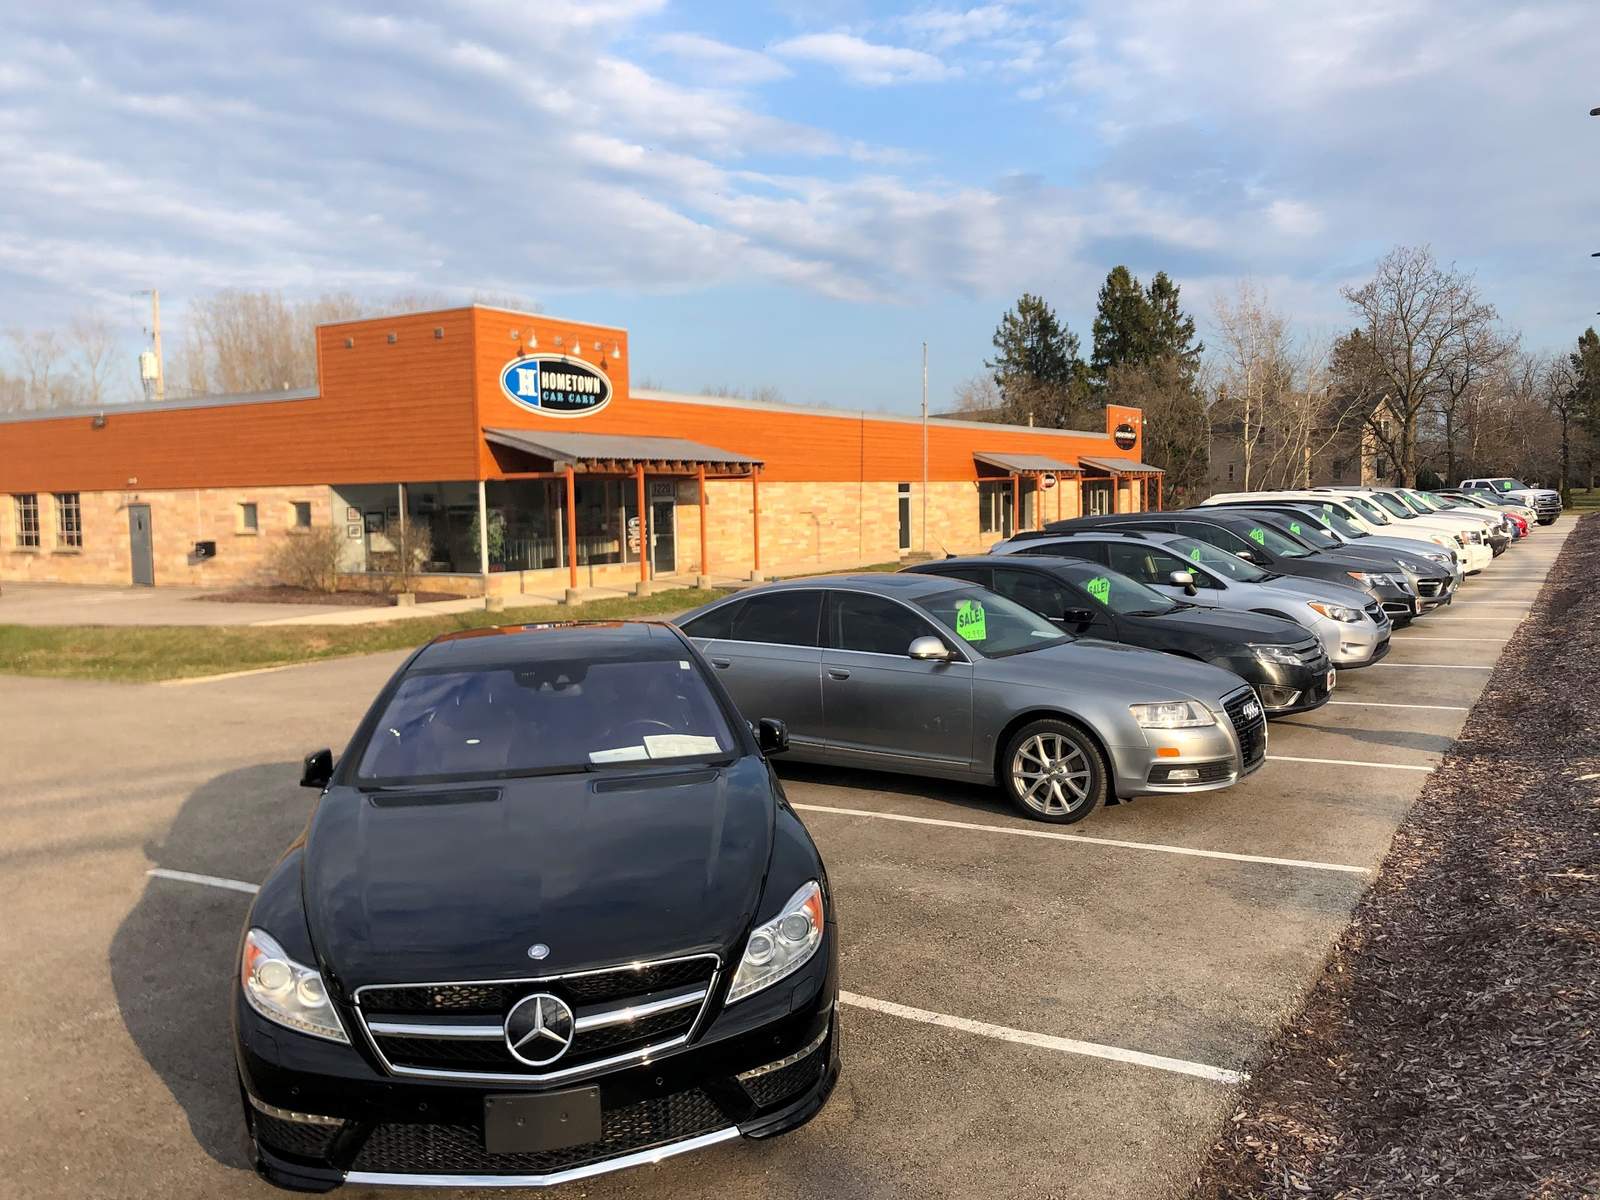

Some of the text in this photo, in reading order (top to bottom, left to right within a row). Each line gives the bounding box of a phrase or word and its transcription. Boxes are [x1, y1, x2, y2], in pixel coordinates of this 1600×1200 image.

[541, 371, 601, 394] HOMETOWN
[542, 391, 596, 405] CAR CARE
[959, 609, 983, 628] SALE!
